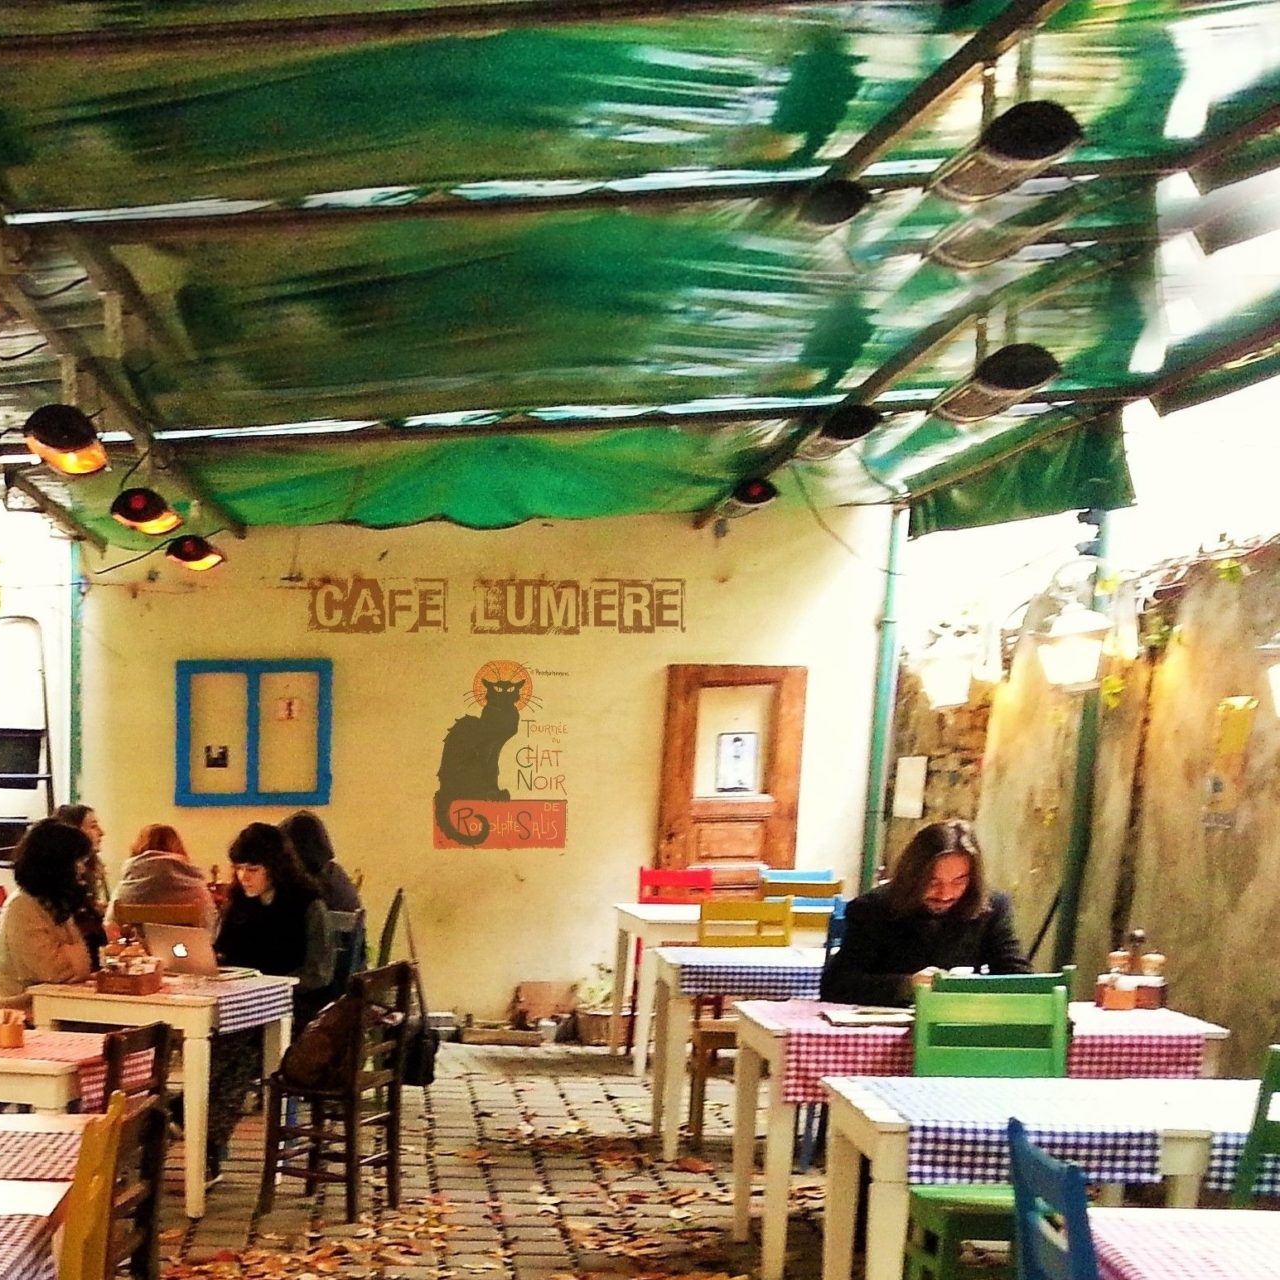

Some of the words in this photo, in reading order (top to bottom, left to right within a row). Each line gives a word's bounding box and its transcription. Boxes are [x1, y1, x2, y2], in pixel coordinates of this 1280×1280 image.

[312, 581, 445, 631] CAFE
[472, 581, 683, 631] LUMIERE
[516, 744, 563, 773] CHAT
[517, 769, 568, 796] NOIR
[543, 802, 561, 812] DE
[516, 811, 558, 840] SALIS
